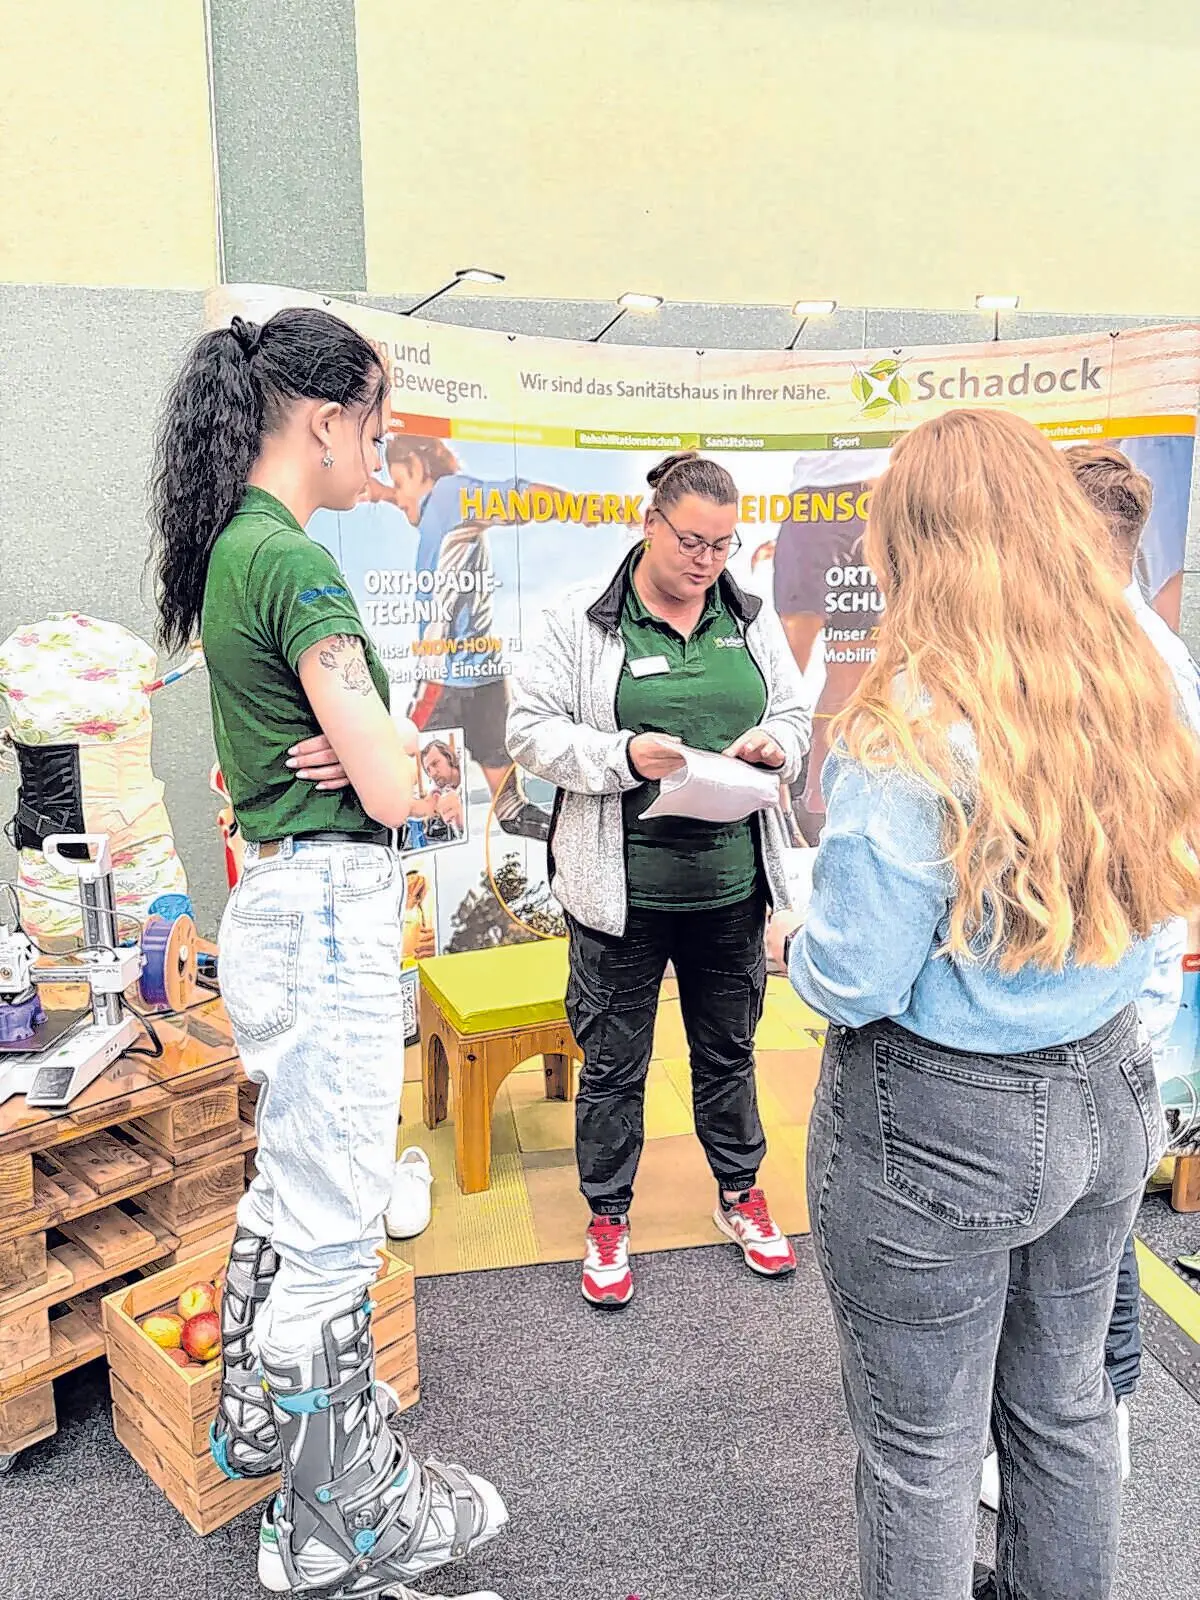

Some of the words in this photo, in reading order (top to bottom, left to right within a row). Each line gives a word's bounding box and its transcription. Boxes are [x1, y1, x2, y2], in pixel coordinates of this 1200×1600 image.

[394, 341, 431, 366] und
[393, 365, 488, 404] Bewegen.
[519, 371, 549, 392] Wir
[551, 374, 583, 394] sind
[586, 377, 613, 396] das
[616, 379, 719, 400] Sanitätshaus
[722, 382, 736, 400] in
[741, 382, 778, 401] Ihrer
[782, 383, 831, 401] Nähe.
[917, 356, 1102, 401] Schadock
[704, 436, 765, 448] Sanitätshaus
[831, 435, 861, 449] Sport
[459, 487, 643, 524] HANDWERK
[741, 491, 869, 524] EIDENSC
[364, 568, 503, 595] ORTHOPÄDIE-
[365, 599, 453, 626] TECHNIK
[411, 636, 503, 657] KNOW-HOW
[823, 627, 868, 642] Unser
[870, 625, 881, 640] Z
[824, 647, 878, 664] Mobilit
[413, 661, 448, 682] ohne
